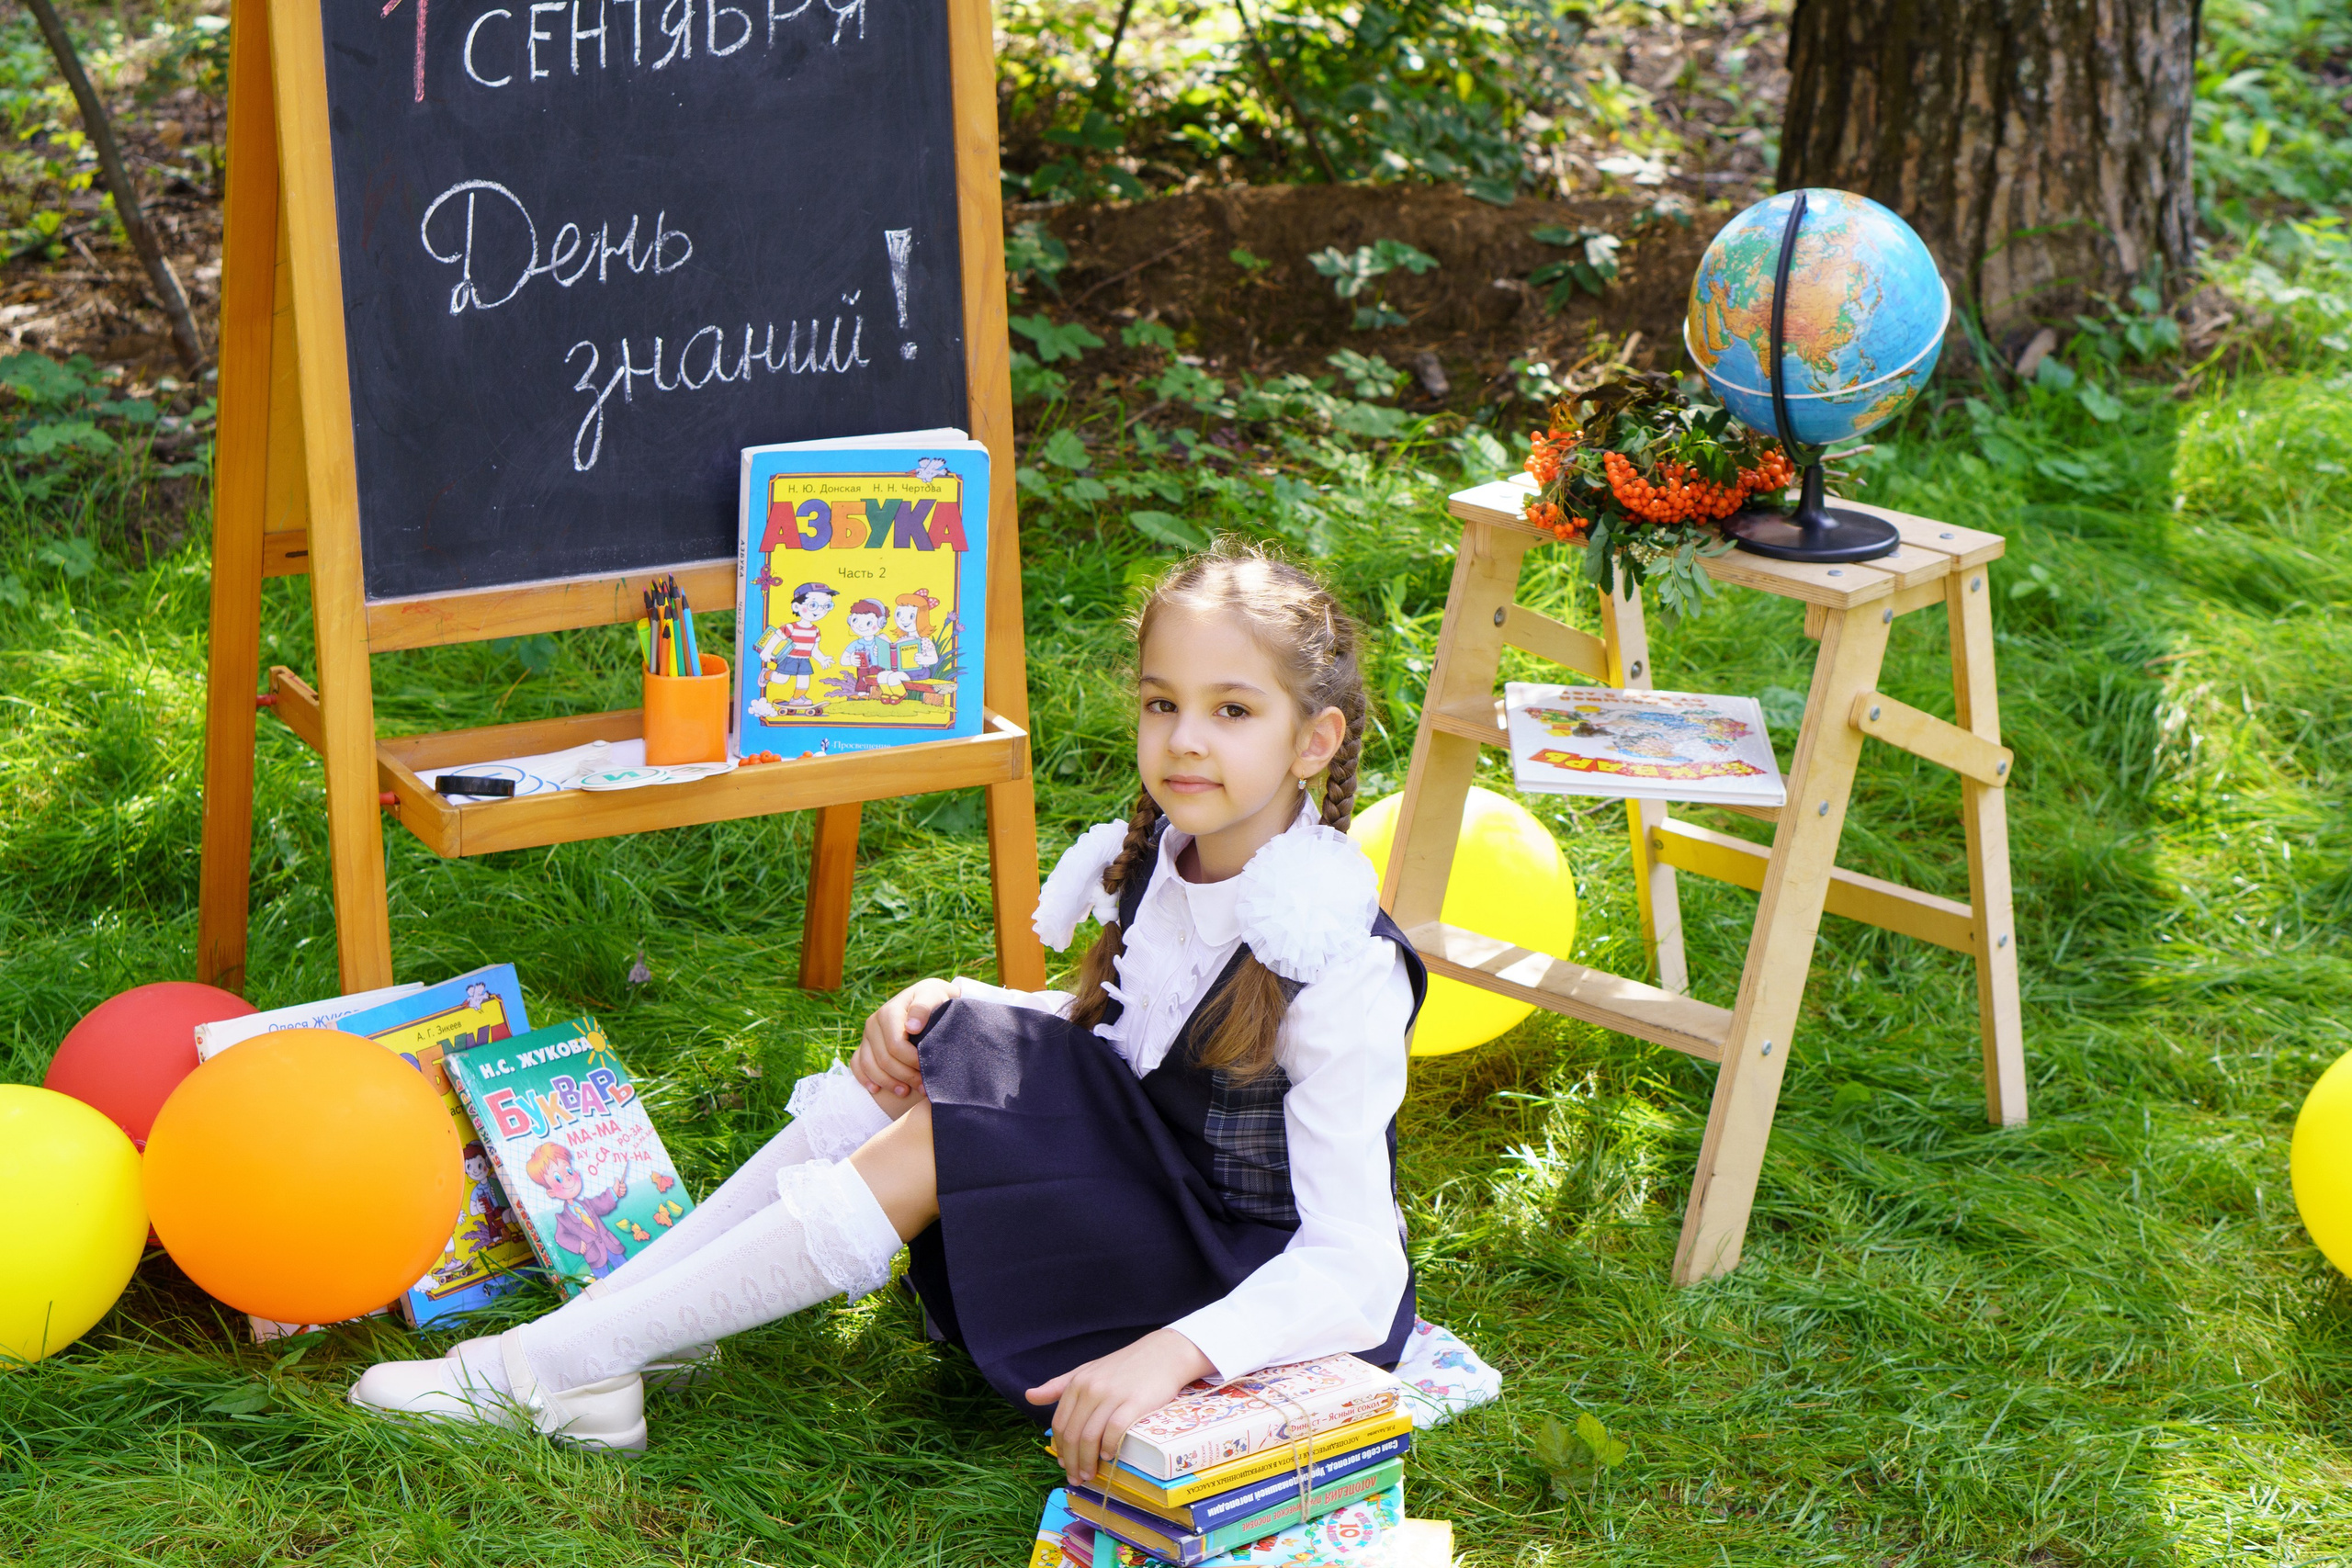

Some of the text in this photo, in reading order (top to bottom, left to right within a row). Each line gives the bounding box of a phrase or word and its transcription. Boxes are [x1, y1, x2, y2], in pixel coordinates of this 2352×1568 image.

[420, 178, 694, 316] День
[788, 483, 942, 495] Н. Ю. Донская Н. Н. Чертова
[758, 498, 970, 553] АЗБУКА
[838, 567, 887, 579] Часть 2
[1542, 750, 1757, 781] БУКВАРЬ
[436, 1021, 462, 1035] Зикеев
[479, 1036, 594, 1080] Н.С. ЖУКОВА
[482, 1067, 636, 1142] БУКВАРЬ
[456, 1078, 503, 1168] БУКВАРЬ
[566, 1120, 622, 1147] МА-МА
[617, 1123, 644, 1147] РО-ЗА
[576, 1148, 589, 1160] АУ
[613, 1150, 652, 1164] ЛУ-НА
[515, 1199, 553, 1269] ЖУКОВА
[1329, 1407, 1355, 1422] Ясный
[1361, 1446, 1381, 1461] себе
[1382, 1439, 1398, 1452] Сам
[1279, 1454, 1303, 1466] РБОТА
[1325, 1453, 1362, 1472] логопед.
[1216, 1464, 1272, 1486] КОРРЕКЦИОННЫХ
[1186, 1480, 1216, 1495] КЛАССАХ
[1254, 1475, 1298, 1501] домашней
[1324, 1475, 1377, 1505] ЛОГОПЕДИЯ
[1207, 1494, 1254, 1517] логопедии
[1241, 1514, 1272, 1532] ПОСОБИЕ
[1340, 1523, 1360, 1538] 10
